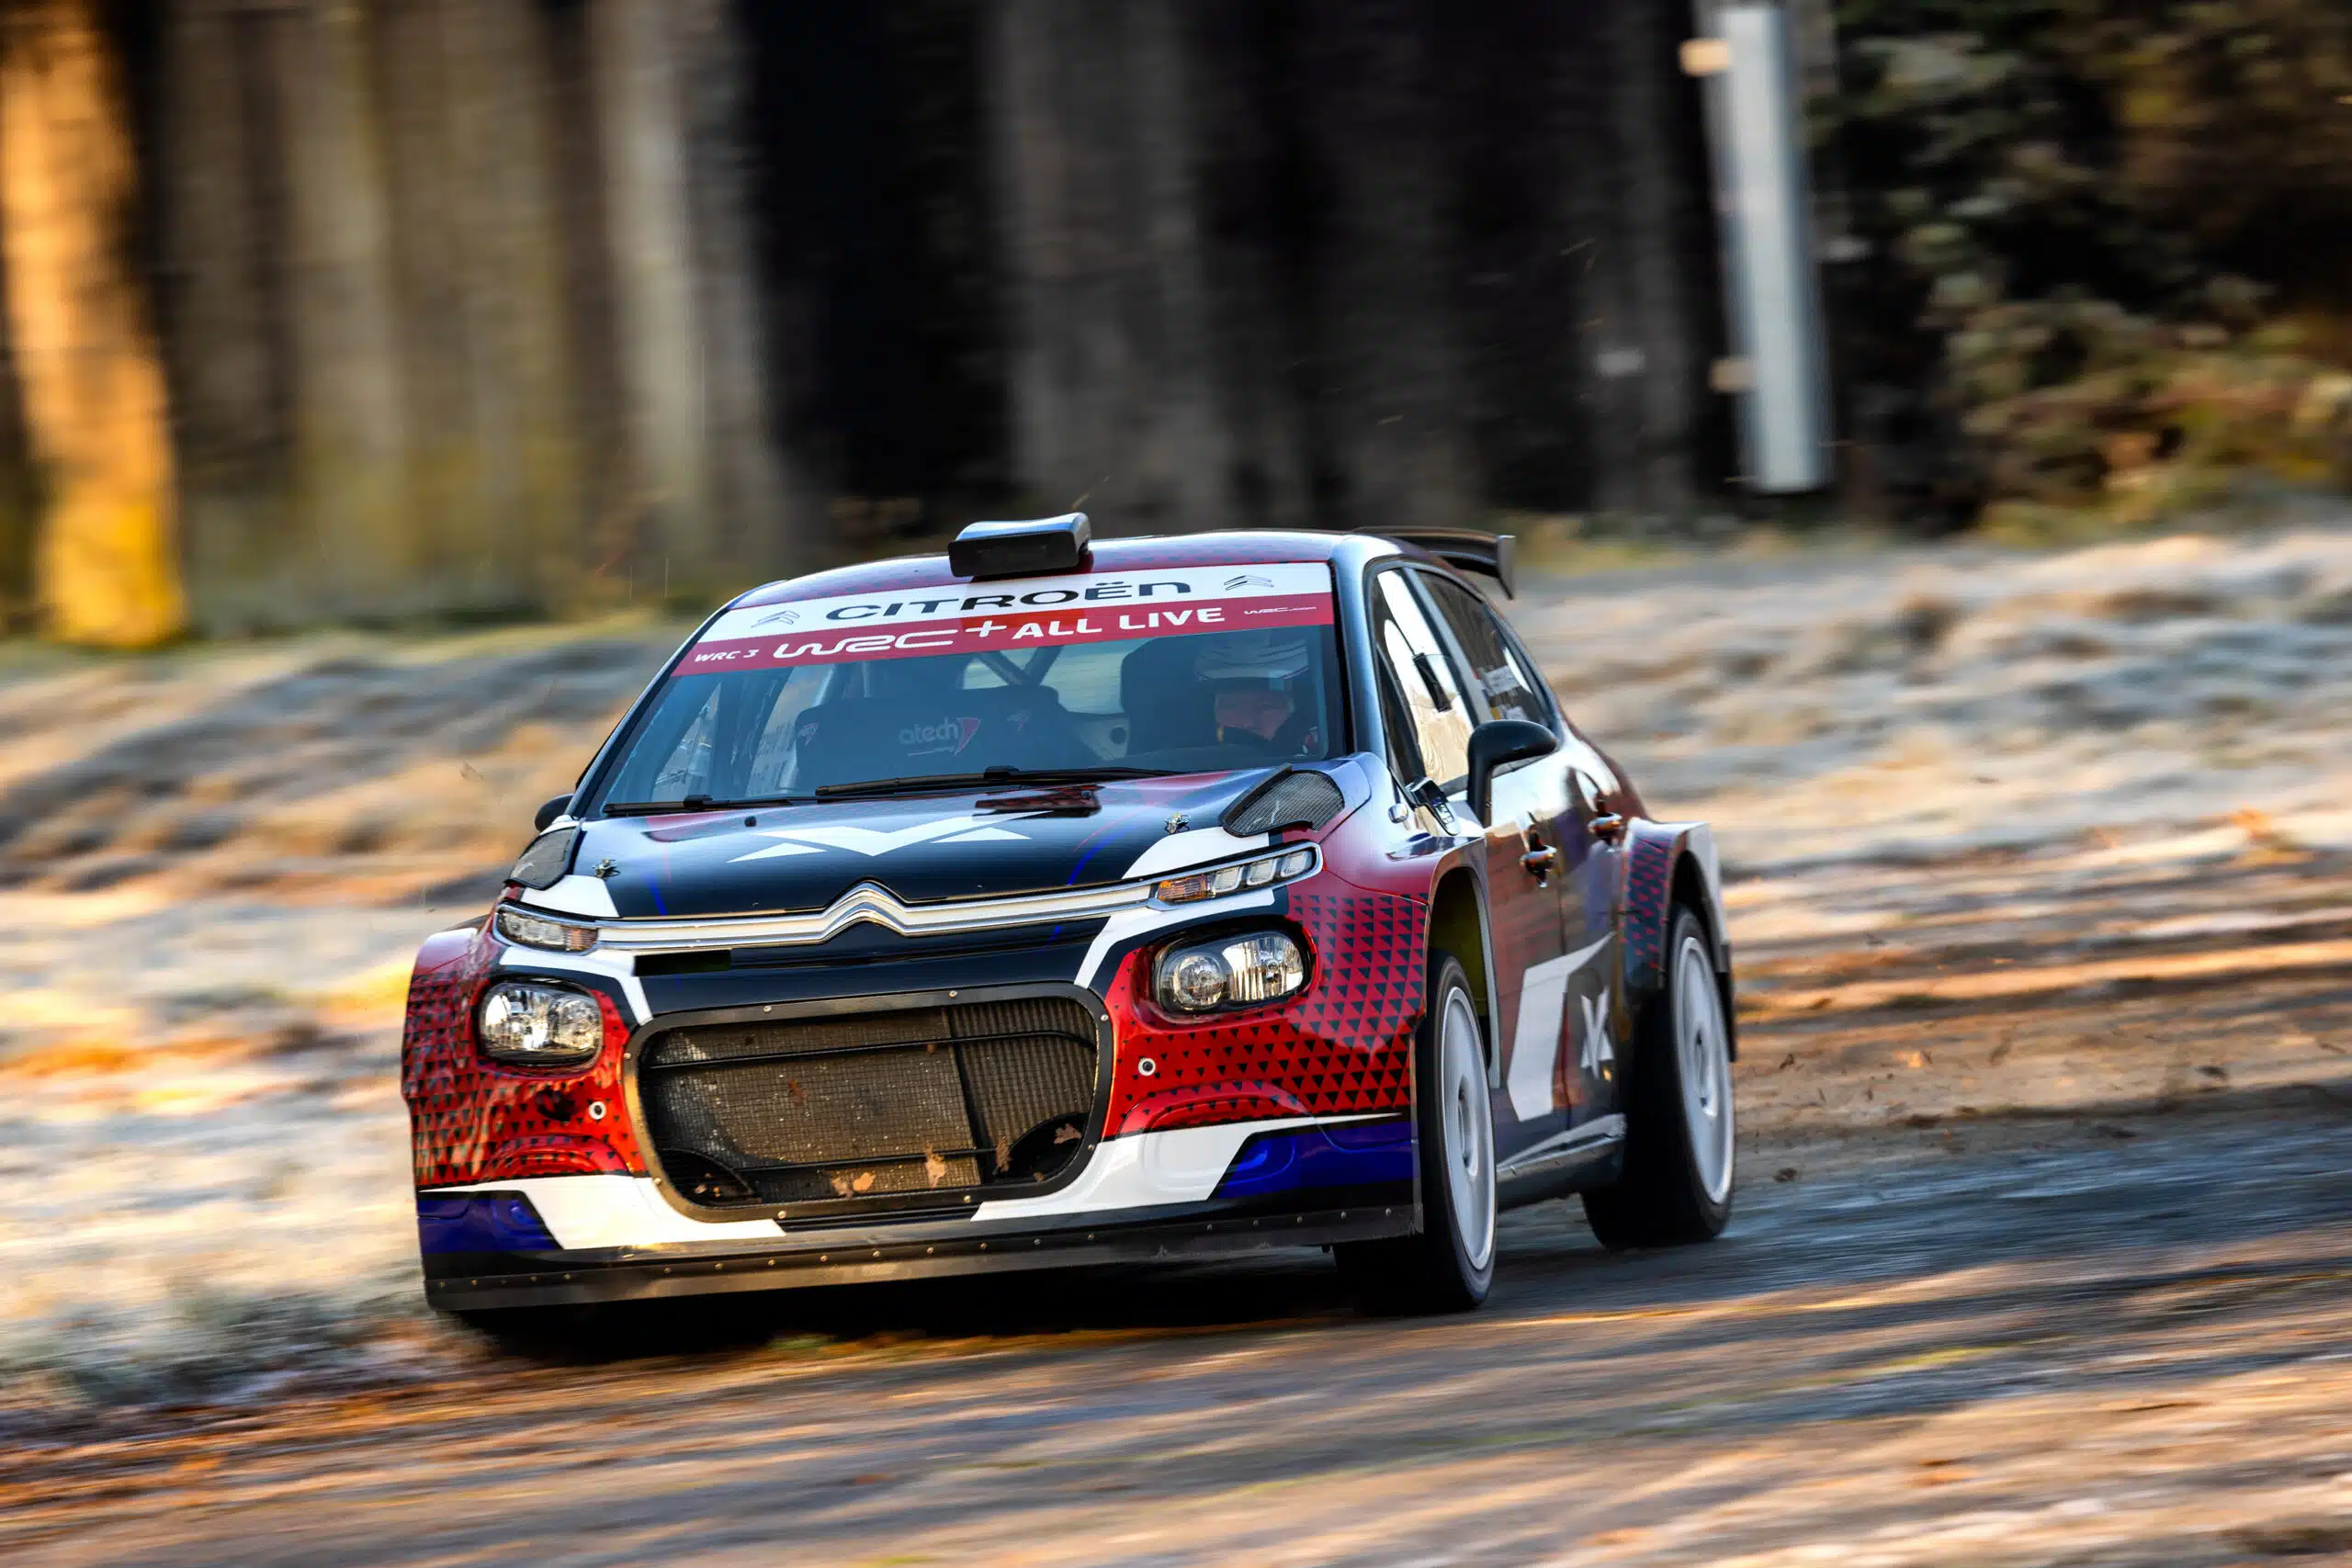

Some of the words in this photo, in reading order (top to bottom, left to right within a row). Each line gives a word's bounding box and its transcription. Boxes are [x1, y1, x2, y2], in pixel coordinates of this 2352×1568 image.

[1012, 618, 1102, 639] ALL
[1119, 607, 1225, 630] LIVE
[695, 650, 741, 662] WRC
[743, 649, 760, 659] 3
